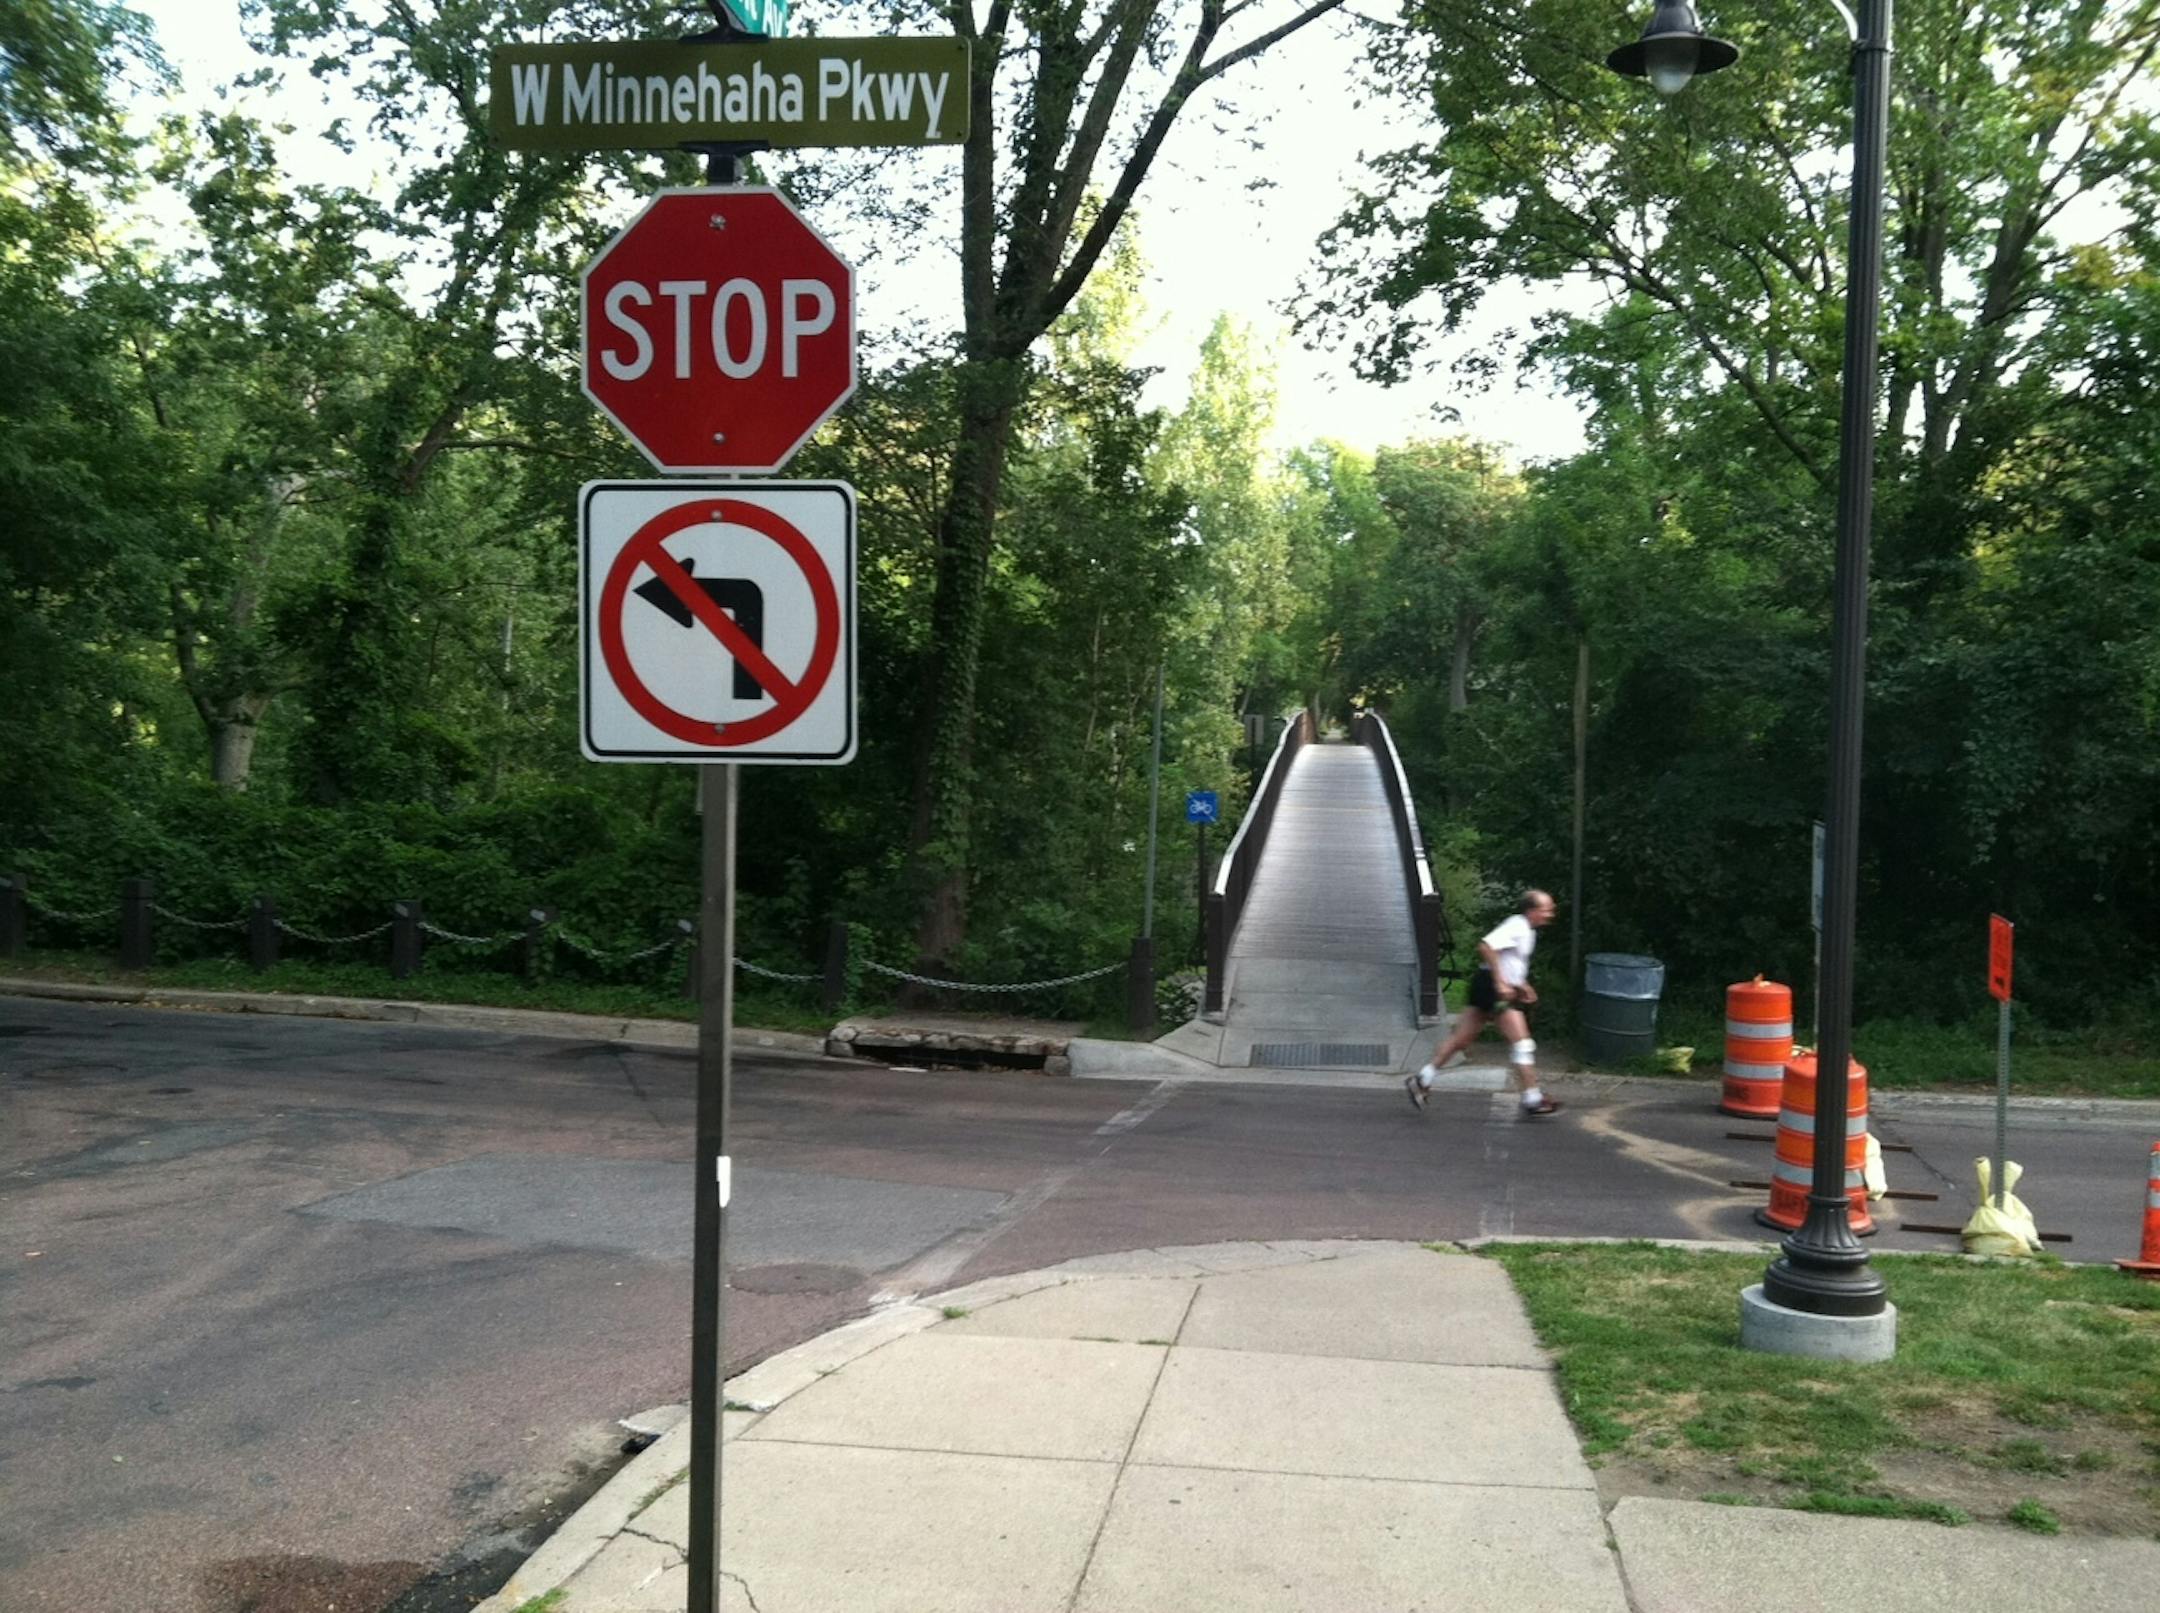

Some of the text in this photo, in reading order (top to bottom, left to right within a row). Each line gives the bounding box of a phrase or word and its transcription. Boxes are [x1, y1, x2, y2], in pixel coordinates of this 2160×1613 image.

[511, 58, 950, 139] W Minnehaha Pkwy
[601, 277, 836, 381] STOP
